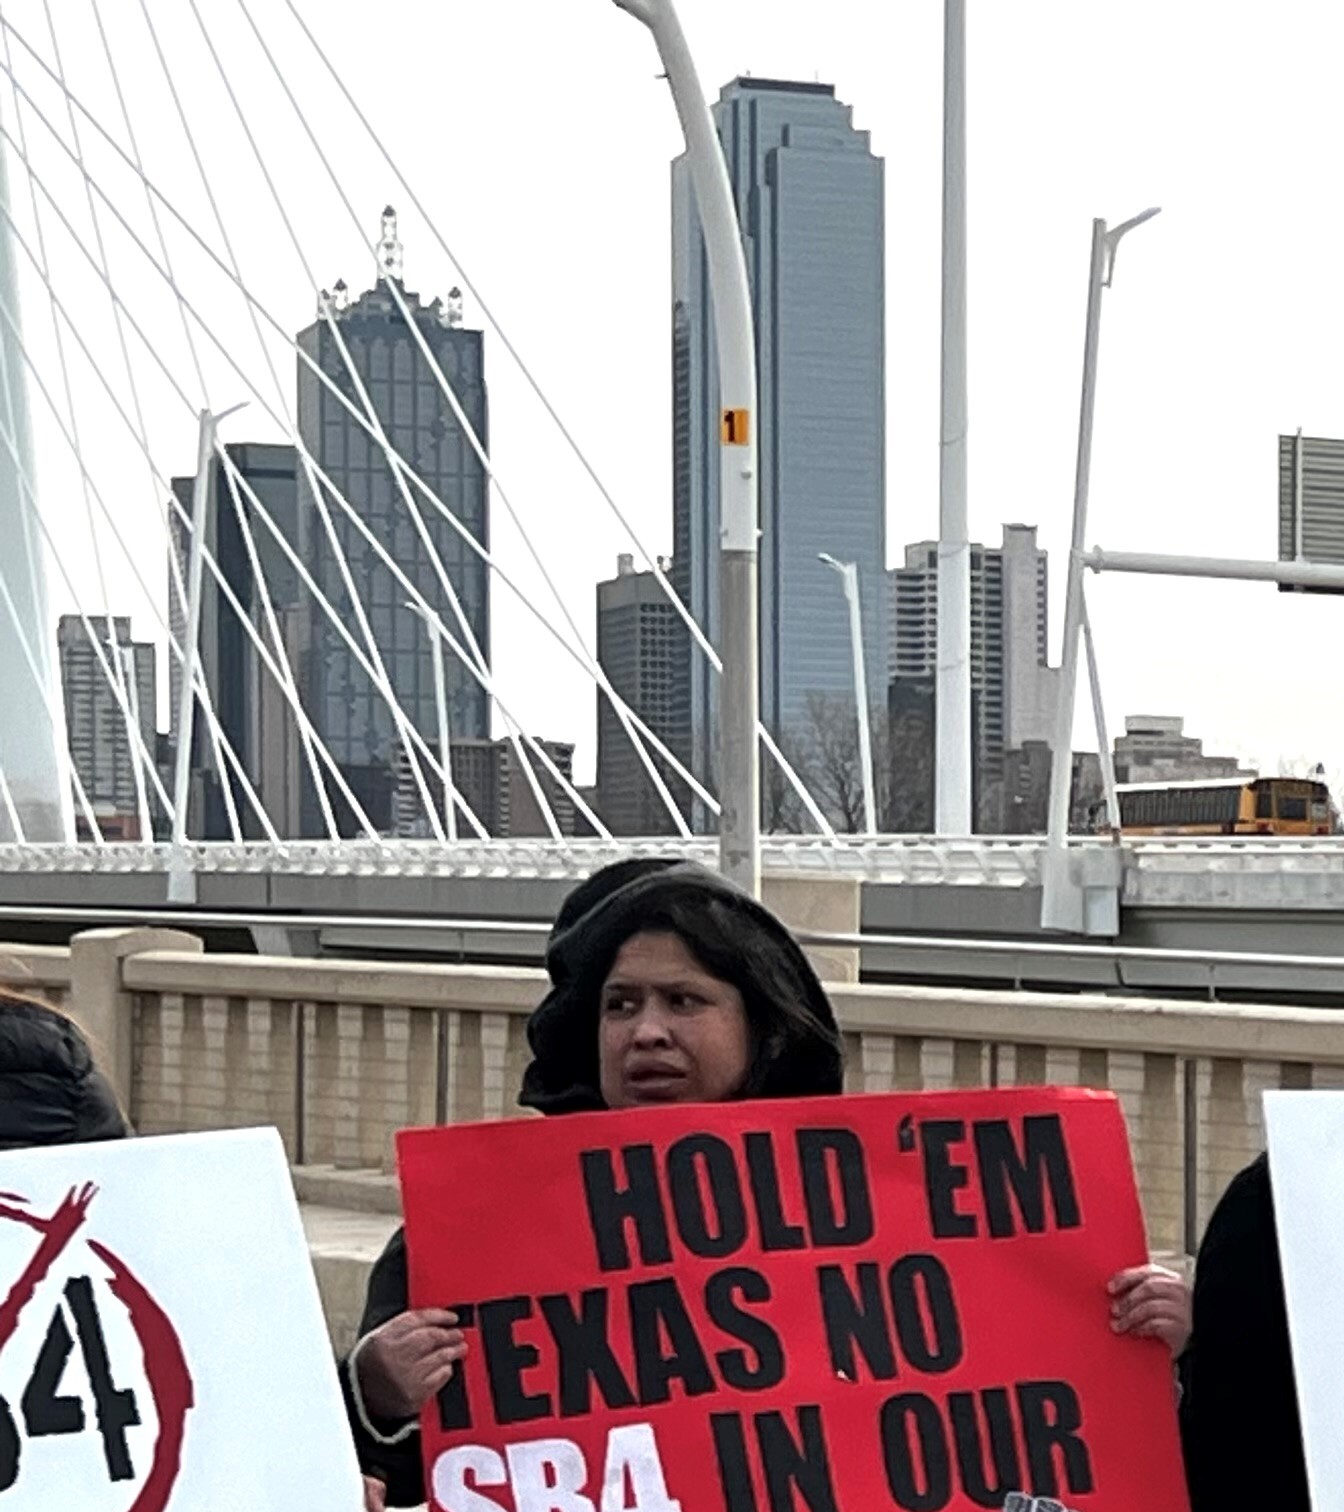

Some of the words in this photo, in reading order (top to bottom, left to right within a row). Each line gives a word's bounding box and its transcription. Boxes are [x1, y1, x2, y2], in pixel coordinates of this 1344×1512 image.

[724, 410, 735, 442] 1
[579, 1126, 876, 1273] HOLD
[818, 1254, 963, 1384] NO
